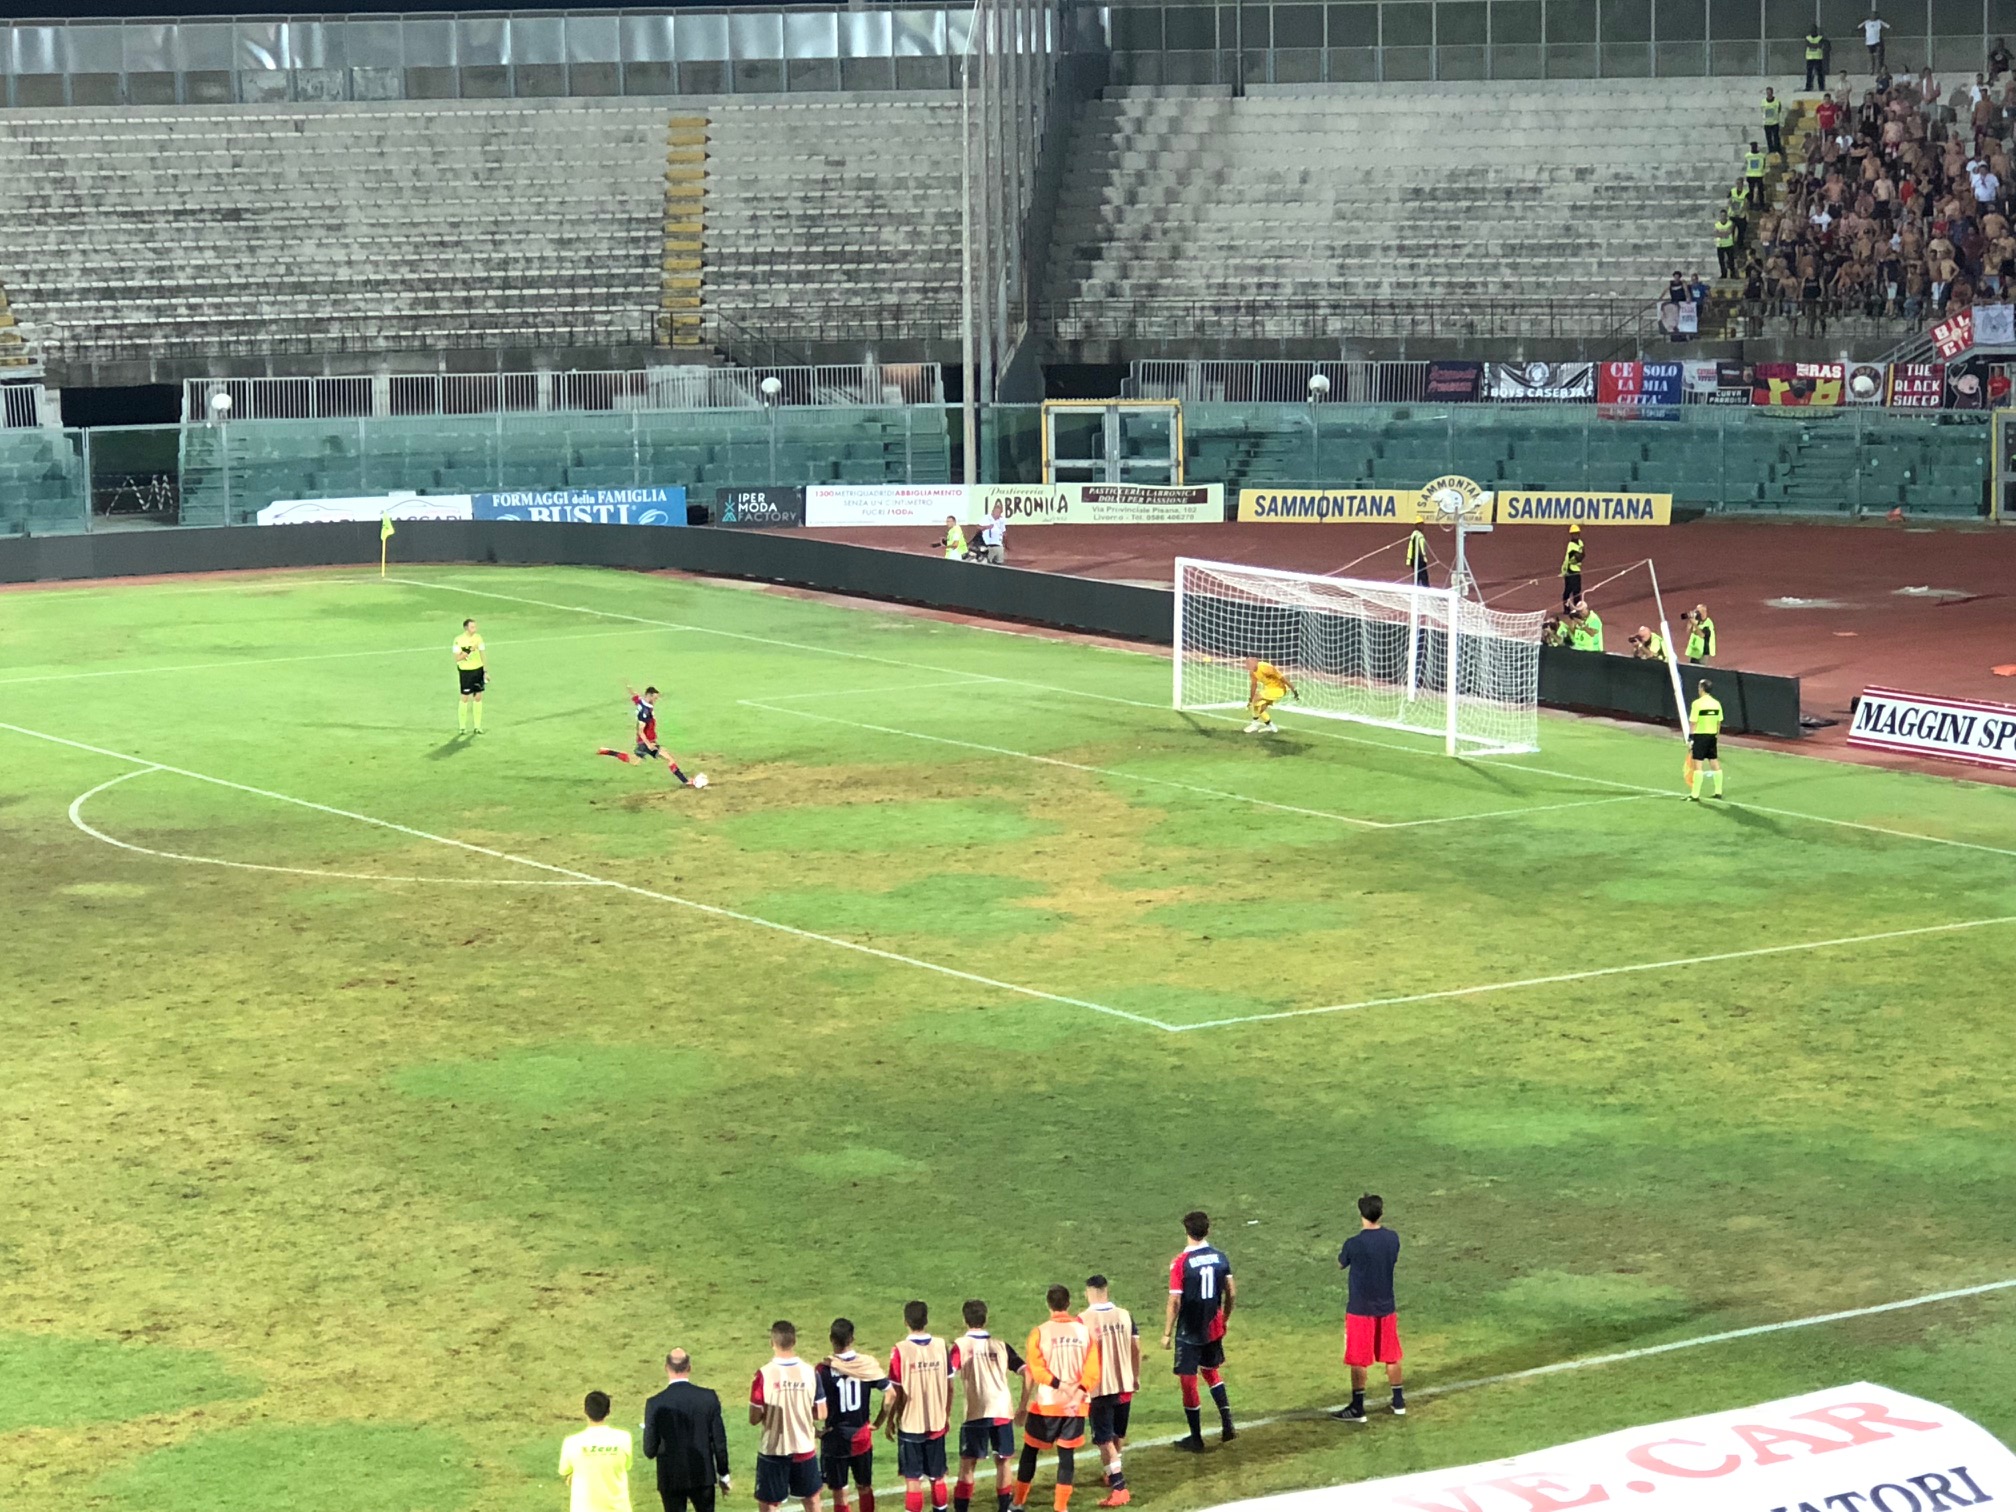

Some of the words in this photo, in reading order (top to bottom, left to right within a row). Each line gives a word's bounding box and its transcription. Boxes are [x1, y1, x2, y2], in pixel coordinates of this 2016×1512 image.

[1610, 363, 1633, 377] CE
[1643, 365, 1677, 376] SOLO
[1906, 364, 1932, 376] THE
[1618, 379, 1634, 391] LA
[1642, 380, 1668, 391] MIA
[1894, 380, 1940, 392] BLACK
[1490, 387, 1524, 398] BOYS
[1526, 387, 1586, 399] CASERTA
[1893, 395, 1940, 406] SHEEP
[895, 489, 963, 497] ABBIGLIAMENTO
[989, 487, 1044, 496] Pasticceria
[1089, 487, 1146, 496] PASTICCERIA
[1146, 489, 1197, 497] LABRONICA
[493, 492, 569, 507] FORMAGGI
[572, 492, 595, 504] della
[598, 489, 667, 503] FAMIGLIA
[738, 493, 765, 503] IPER
[738, 503, 778, 513] MODA
[1254, 494, 1397, 518] SAMMONTANA
[1508, 496, 1654, 519] SAMMONTANA
[528, 504, 631, 525] BUSTI
[738, 512, 797, 522] FACTORY
[1856, 701, 1977, 745] MAGGINI
[1978, 718, 2016, 751] SP
[1199, 1265, 1214, 1299] 11
[836, 1376, 861, 1413] 10
[591, 1445, 618, 1453] Zeus
